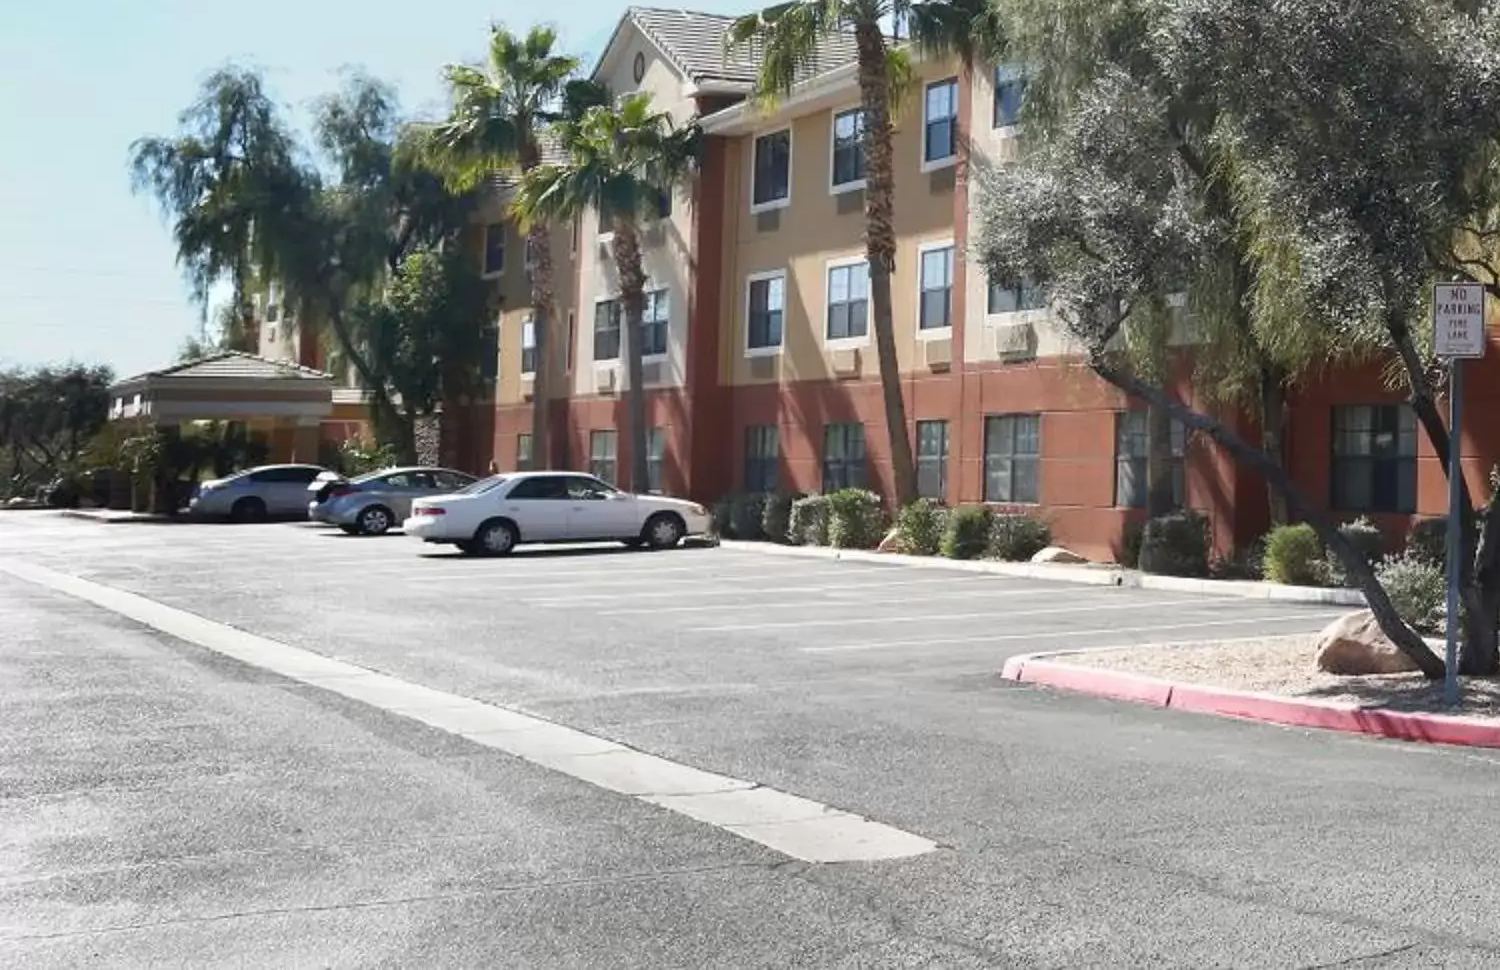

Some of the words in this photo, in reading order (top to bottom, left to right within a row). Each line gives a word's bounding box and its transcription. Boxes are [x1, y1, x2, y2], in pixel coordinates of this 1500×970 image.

[1451, 288, 1467, 300] NO
[1437, 303, 1481, 315] PARKING
[1449, 319, 1468, 329] FIRE
[1447, 331, 1468, 341] LANE
